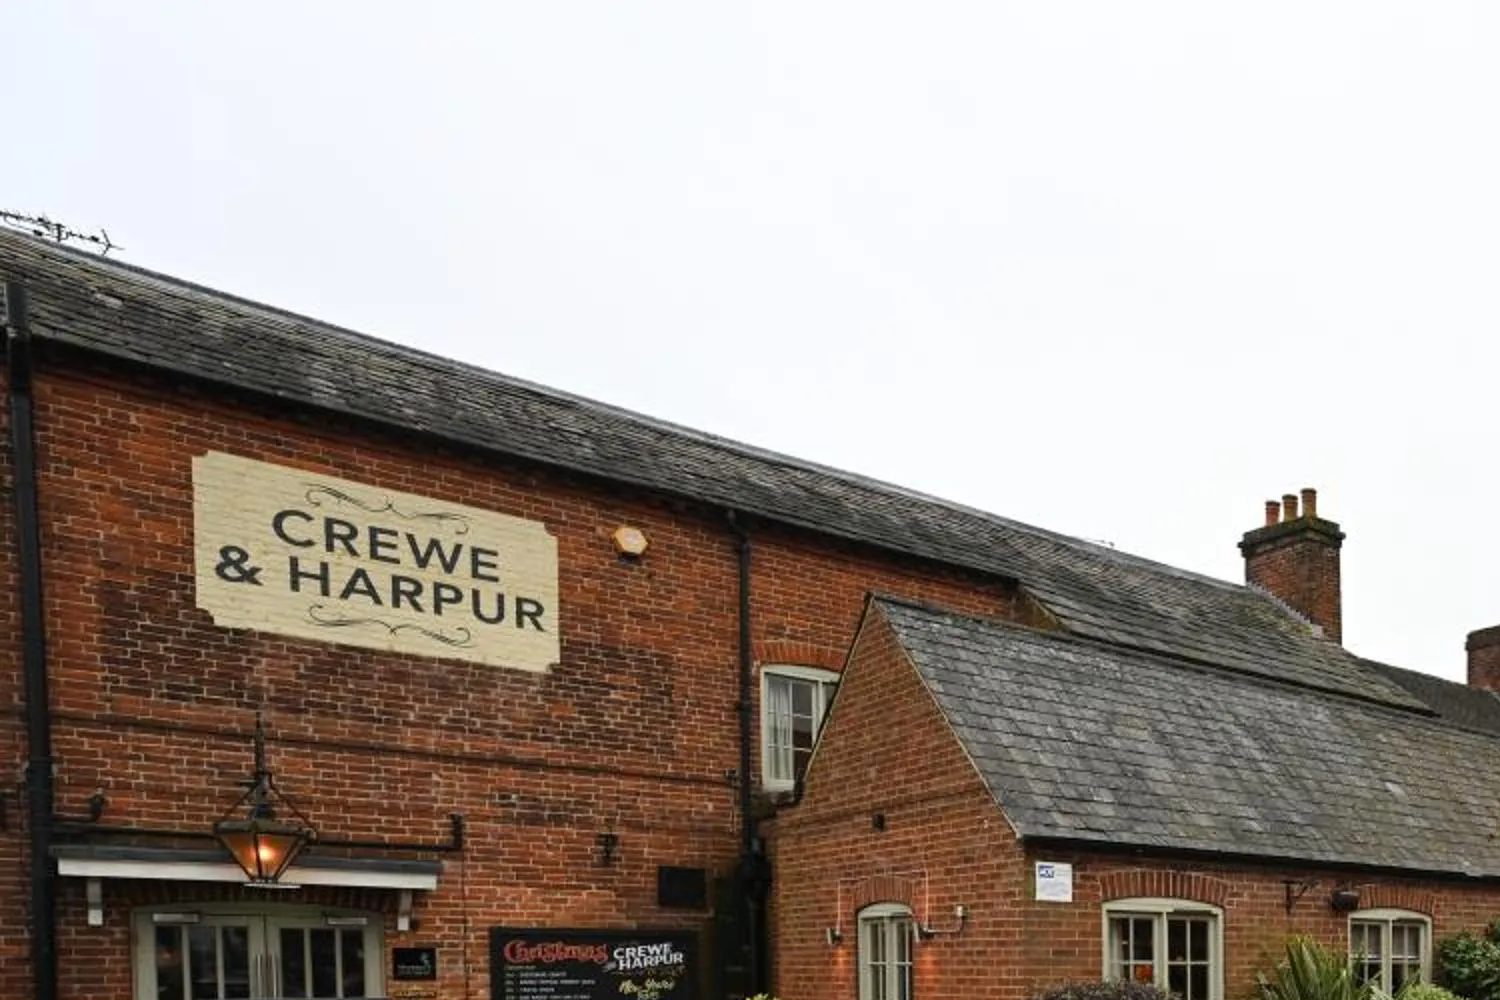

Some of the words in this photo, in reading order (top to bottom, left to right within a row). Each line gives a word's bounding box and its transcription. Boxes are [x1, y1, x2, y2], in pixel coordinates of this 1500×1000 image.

[272, 509, 500, 582] CREWE
[215, 545, 263, 585] &
[289, 556, 546, 632] HARPUR
[504, 939, 608, 964] Christmas
[613, 943, 672, 960] CREWE
[619, 952, 683, 970] HARPUR
